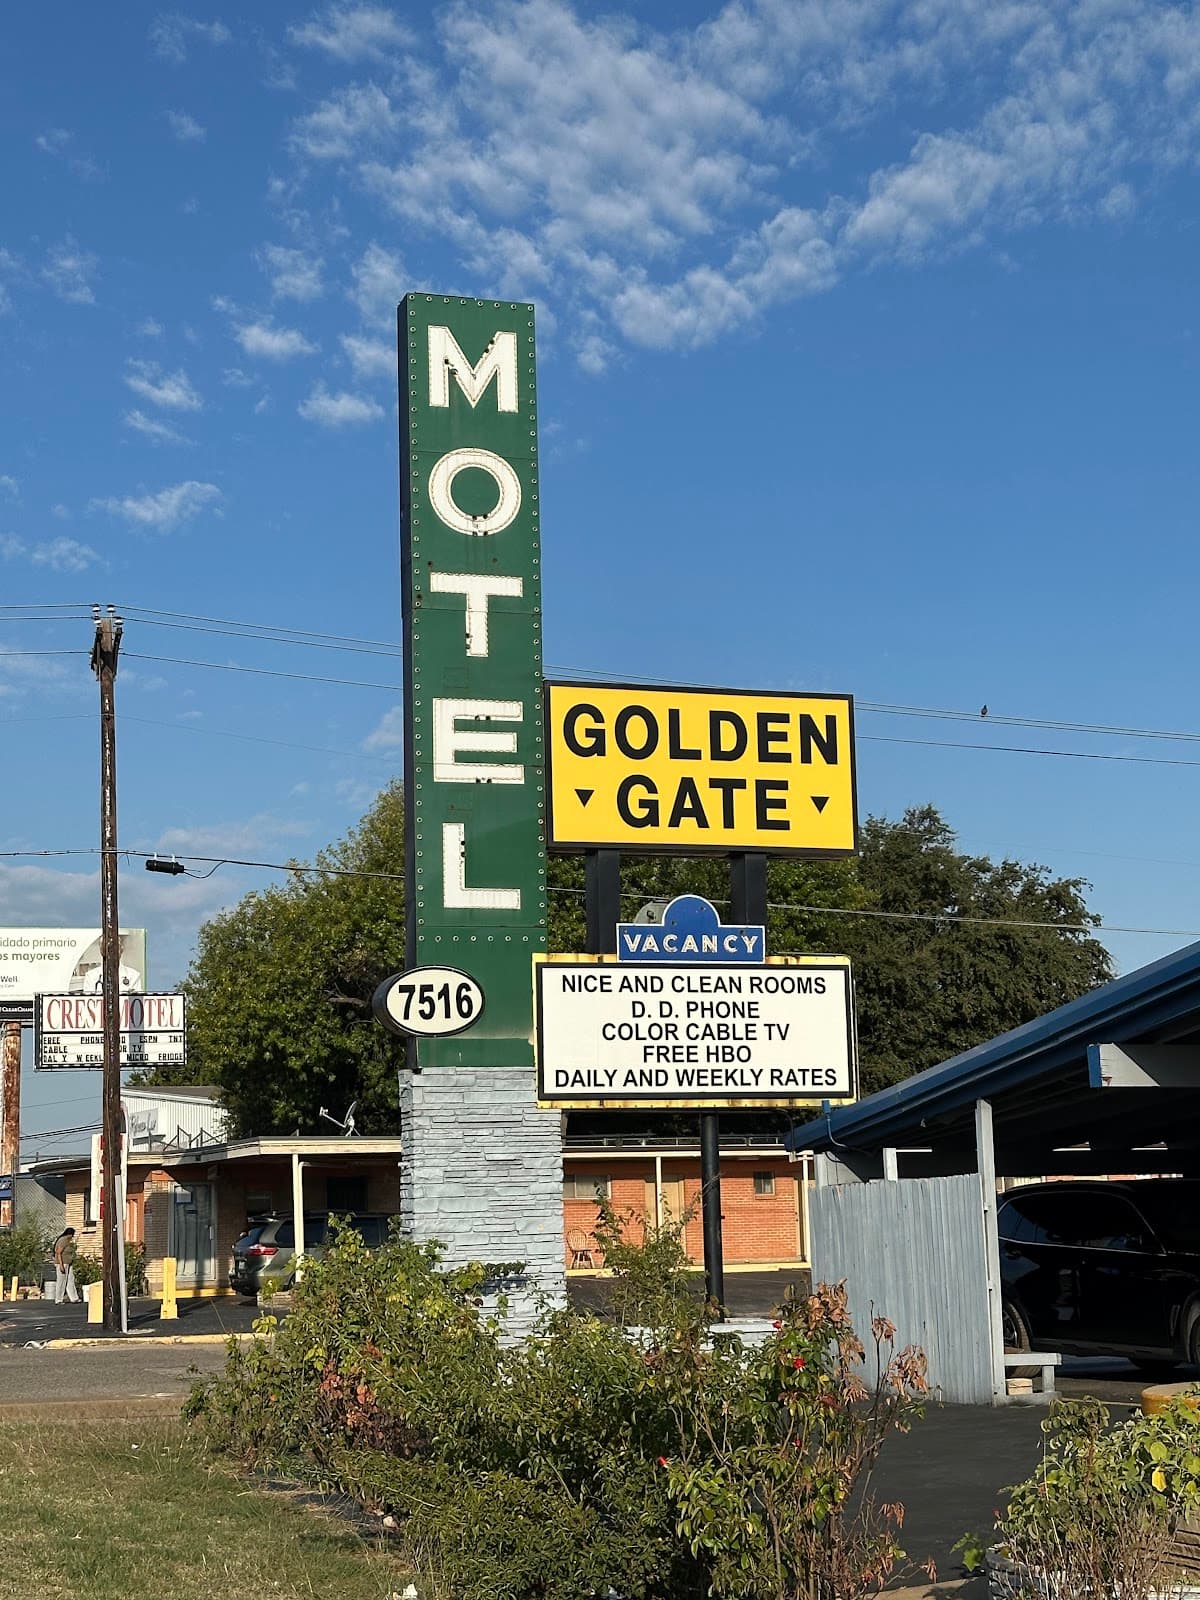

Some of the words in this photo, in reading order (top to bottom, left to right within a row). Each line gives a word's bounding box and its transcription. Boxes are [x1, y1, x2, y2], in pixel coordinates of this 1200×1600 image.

[428, 325, 524, 910] MOTEL
[563, 703, 838, 765] GOLDEN
[617, 774, 791, 831] GATE
[33, 937, 77, 950] primario
[623, 934, 759, 953] VACANCY
[12, 953, 60, 963] mayores
[561, 975, 612, 993] NICE
[619, 975, 664, 993] AND
[671, 975, 742, 994] CLEAN
[750, 976, 826, 994] ROOMS
[398, 983, 473, 1020] 7516
[632, 1001, 651, 1018] D.
[659, 1001, 679, 1018] D.
[687, 1001, 760, 1018] PHONE
[47, 999, 105, 1029] CREST
[44, 1036, 61, 1044] FREE
[139, 1035, 158, 1043] ESPN
[602, 1023, 678, 1041] COLOR
[686, 1023, 757, 1041] CABLE
[764, 1023, 790, 1041] TV
[159, 1053, 183, 1061] FRIDGE
[643, 1045, 698, 1063] FREE
[706, 1045, 752, 1063] HBO
[555, 1069, 617, 1087] DAILY
[623, 1069, 668, 1087] AND
[676, 1068, 763, 1086] WEEKLY
[770, 1068, 837, 1086] RATES
